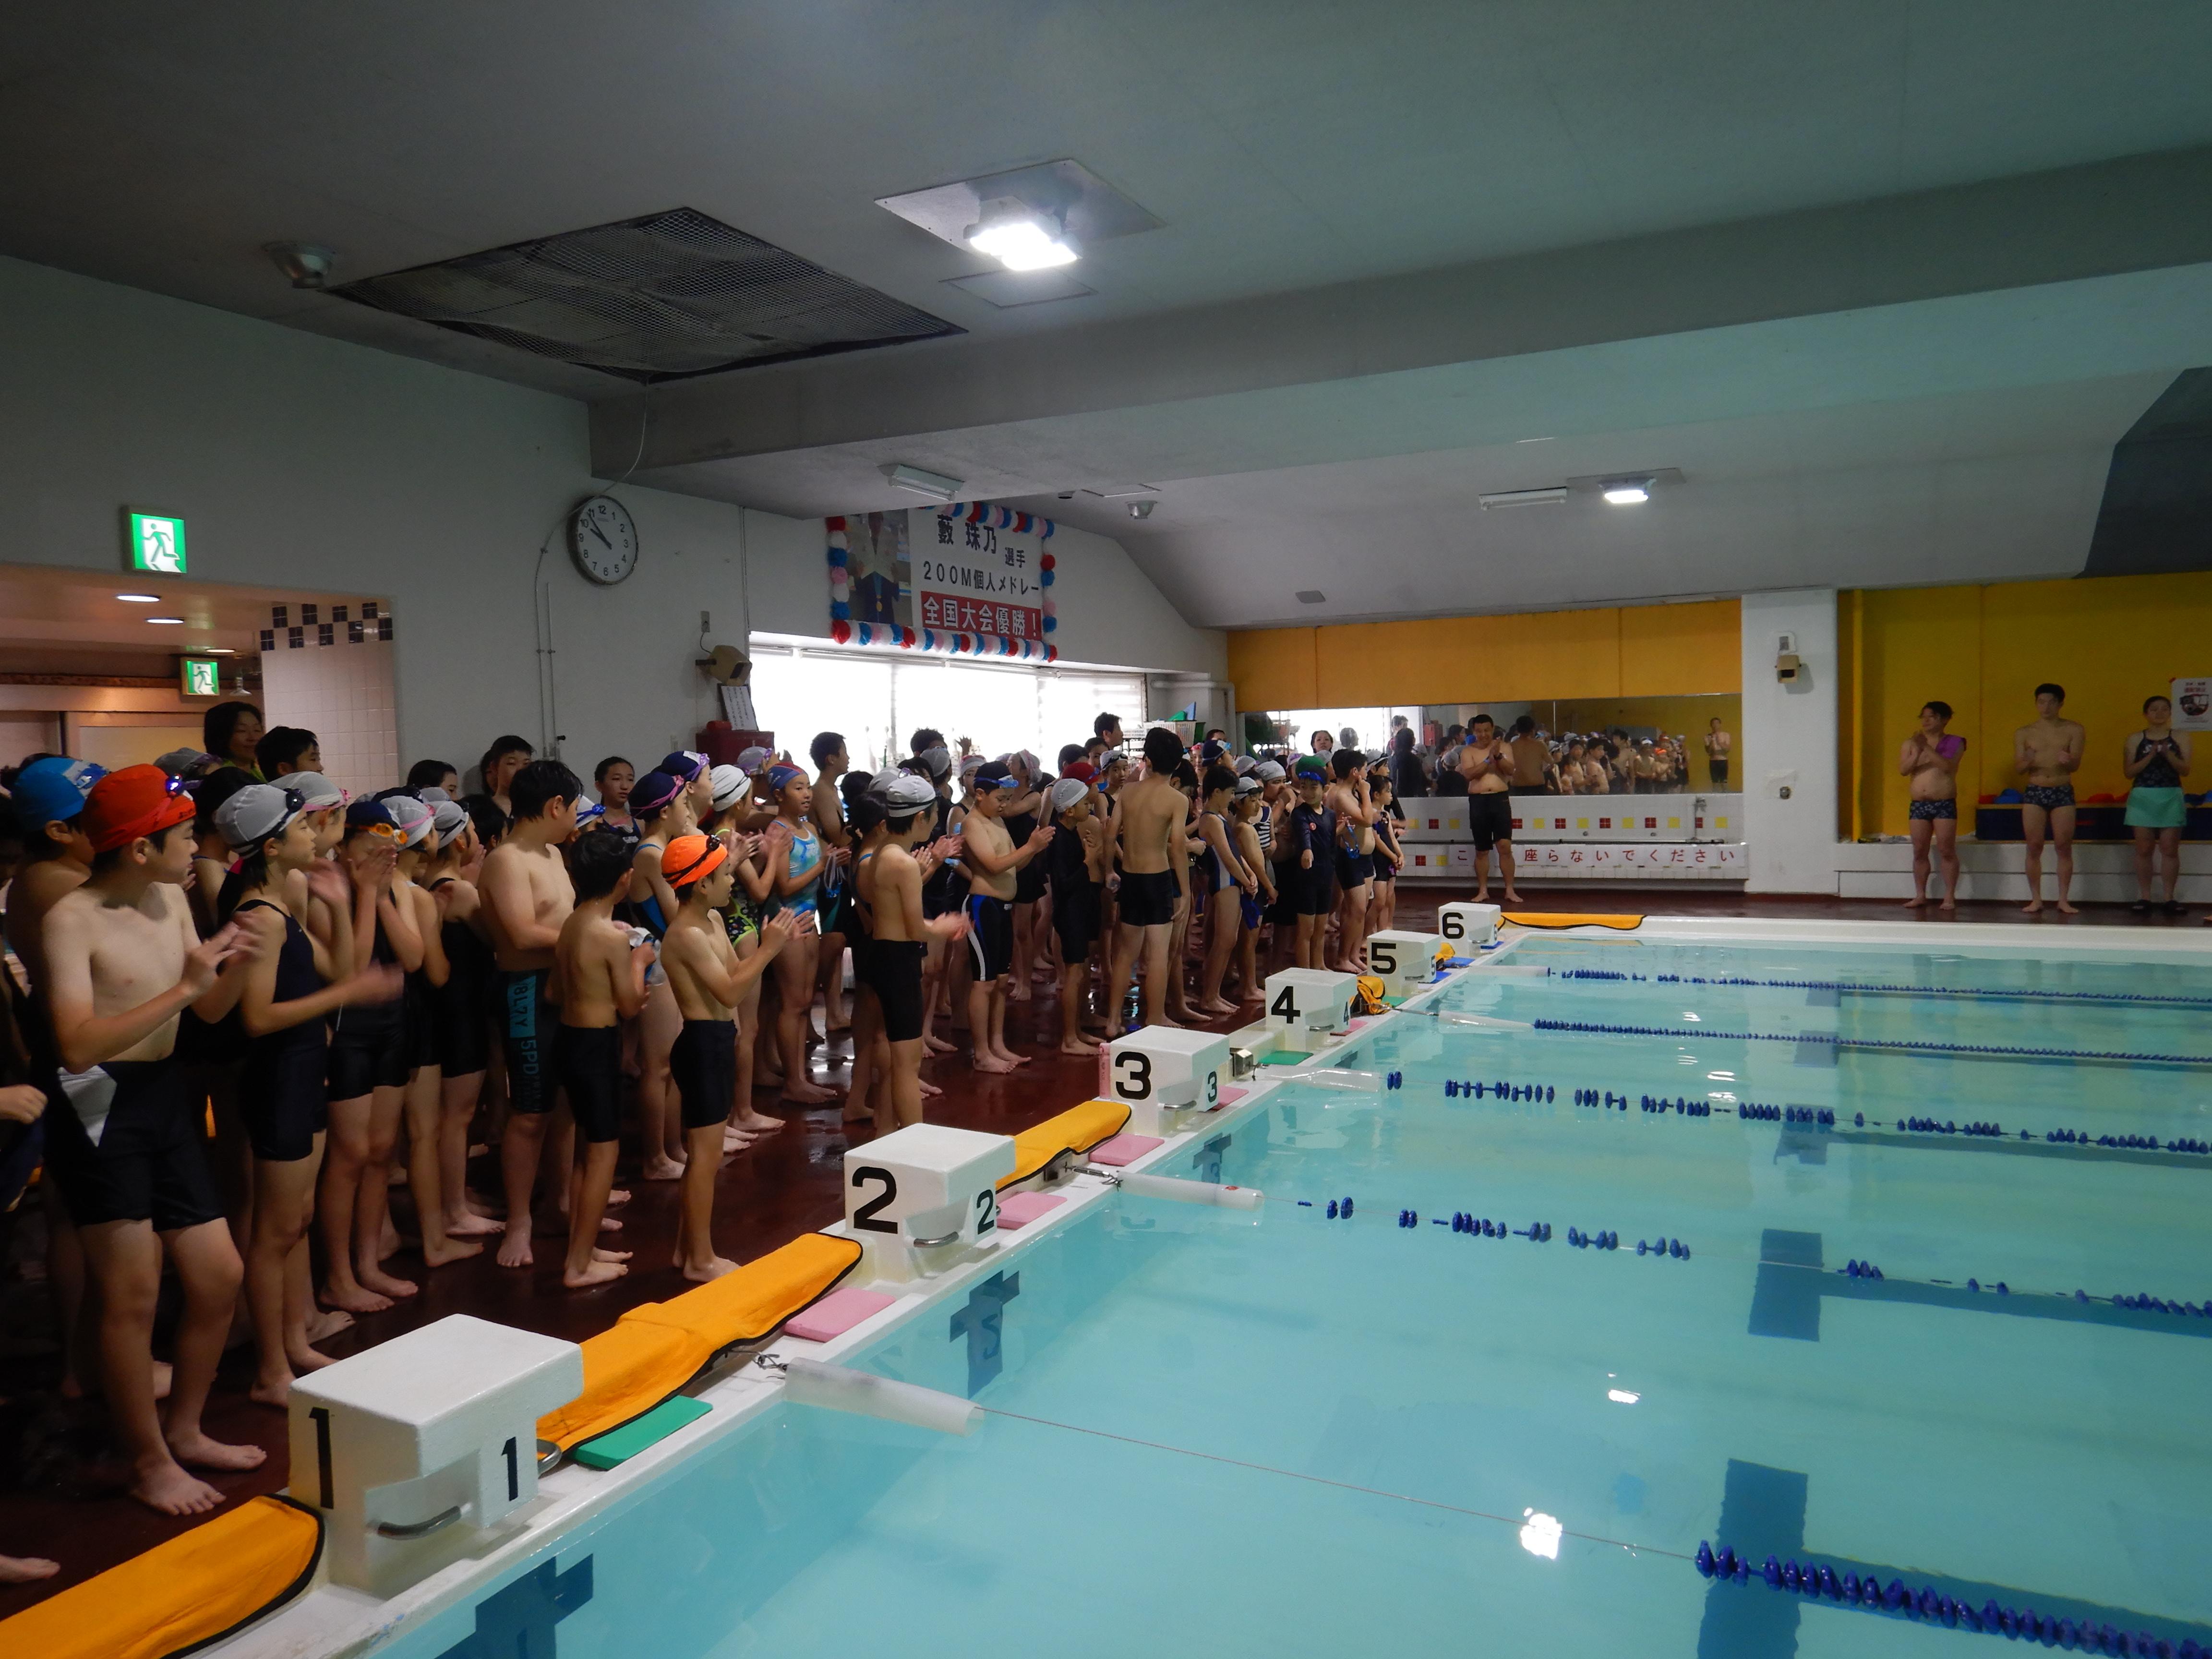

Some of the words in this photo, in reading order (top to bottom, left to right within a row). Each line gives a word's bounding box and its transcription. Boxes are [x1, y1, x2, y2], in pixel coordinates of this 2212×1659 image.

[598, 505, 606, 514] 12
[612, 512, 616, 520] 1
[580, 518, 589, 528] 10
[620, 524, 625, 532] 2
[578, 533, 584, 542] 9
[624, 539, 629, 548] 3
[583, 549, 589, 559] 8
[622, 554, 626, 563] 4
[1005, 547, 1026, 568] 選手
[592, 562, 598, 571] 7
[603, 567, 608, 576] 6
[614, 565, 619, 573] 5
[923, 561, 1039, 595] 200M個人メドレー
[923, 596, 1037, 637] 全国大会優勝！
[1442, 912, 1464, 939] 6
[1371, 942, 1396, 974] 5
[1431, 955, 1435, 976] 5
[1271, 986, 1300, 1024] 4
[1344, 1001, 1349, 1026] 4
[1115, 1051, 1151, 1100] 3
[1207, 1071, 1217, 1103] 3
[852, 1166, 898, 1234] 2
[976, 1190, 995, 1235] 2
[309, 1407, 334, 1509] 1
[501, 1437, 518, 1502] 1
